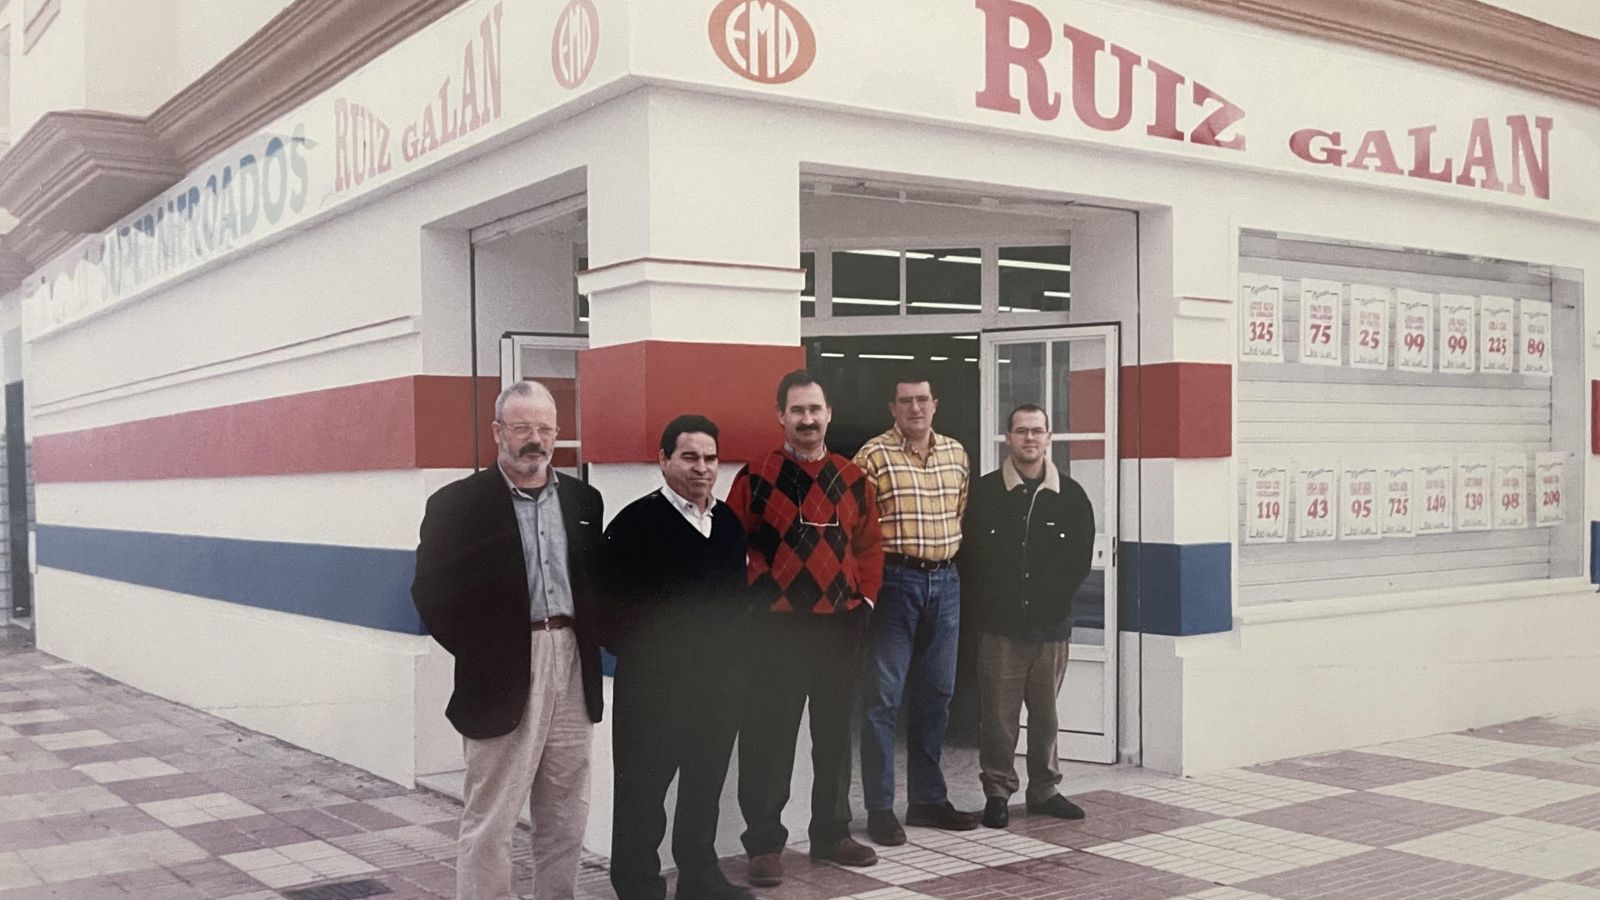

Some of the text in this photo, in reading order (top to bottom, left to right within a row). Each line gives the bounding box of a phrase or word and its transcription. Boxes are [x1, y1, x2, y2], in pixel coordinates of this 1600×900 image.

[726, 1, 799, 78] EMD
[333, 96, 392, 194] RUIZ
[401, 2, 504, 163] GALAN
[975, 0, 1554, 200] RUIZ GALAN
[1249, 321, 1274, 343] 325
[1309, 323, 1332, 345] 75
[1359, 329, 1380, 350] 25
[1404, 332, 1425, 353] 99
[1447, 335, 1468, 355] 99
[1488, 336, 1508, 356] 225
[1527, 337, 1546, 358] 89
[1257, 501, 1281, 522] 119
[1306, 498, 1329, 519] 43
[1351, 498, 1373, 519] 95
[1501, 492, 1521, 511] 98
